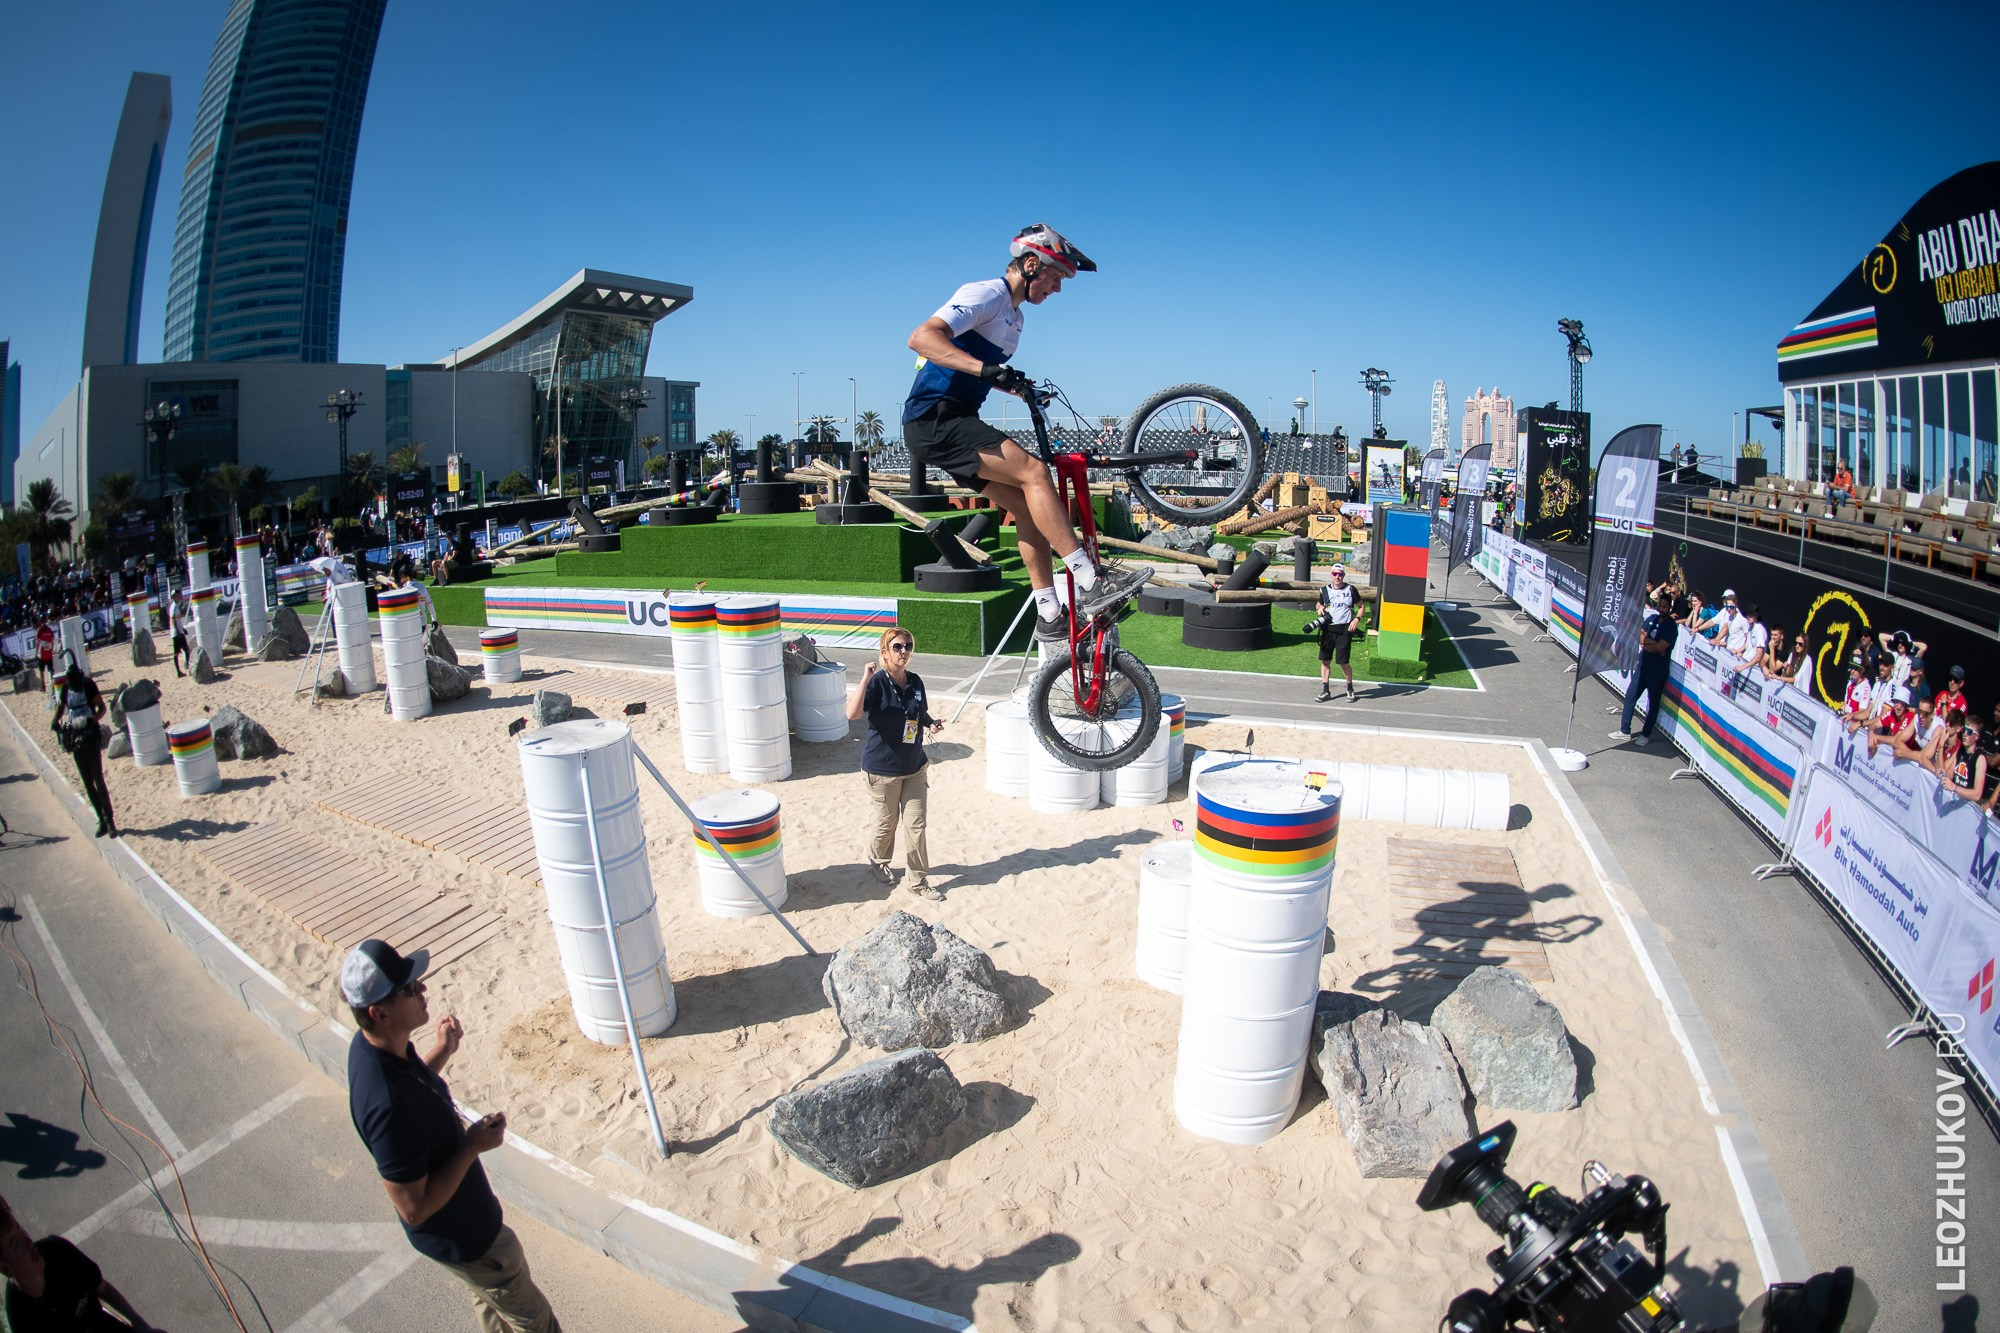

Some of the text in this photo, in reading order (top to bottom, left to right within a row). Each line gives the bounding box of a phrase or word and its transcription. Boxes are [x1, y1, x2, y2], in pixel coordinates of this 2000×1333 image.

[1918, 223, 1957, 282] ABU
[1935, 274, 1955, 304] UCI
[1955, 263, 1997, 301] URBAN
[1943, 293, 2000, 325] WORLD CHA
[1546, 432, 1569, 448] ظبي
[590, 470, 611, 479] 12:52:03
[1428, 462, 1437, 475] 4
[1468, 463, 1480, 484] 3
[397, 488, 424, 500] 12:52:03
[1615, 467, 1637, 509] 2
[1612, 518, 1633, 531] UCI
[267, 568, 273, 579] 3
[1601, 556, 1618, 620] Abu Dhabi
[1610, 557, 1627, 622] Sports Council
[627, 600, 669, 627] UC
[1685, 644, 1695, 658] UCI
[1724, 667, 1735, 681] UCI
[1770, 697, 1782, 714] UCI
[1875, 780, 1897, 801] Equipment
[1896, 796, 1911, 811] Rental
[1834, 845, 1920, 943] Bin Hamoodah Auto
